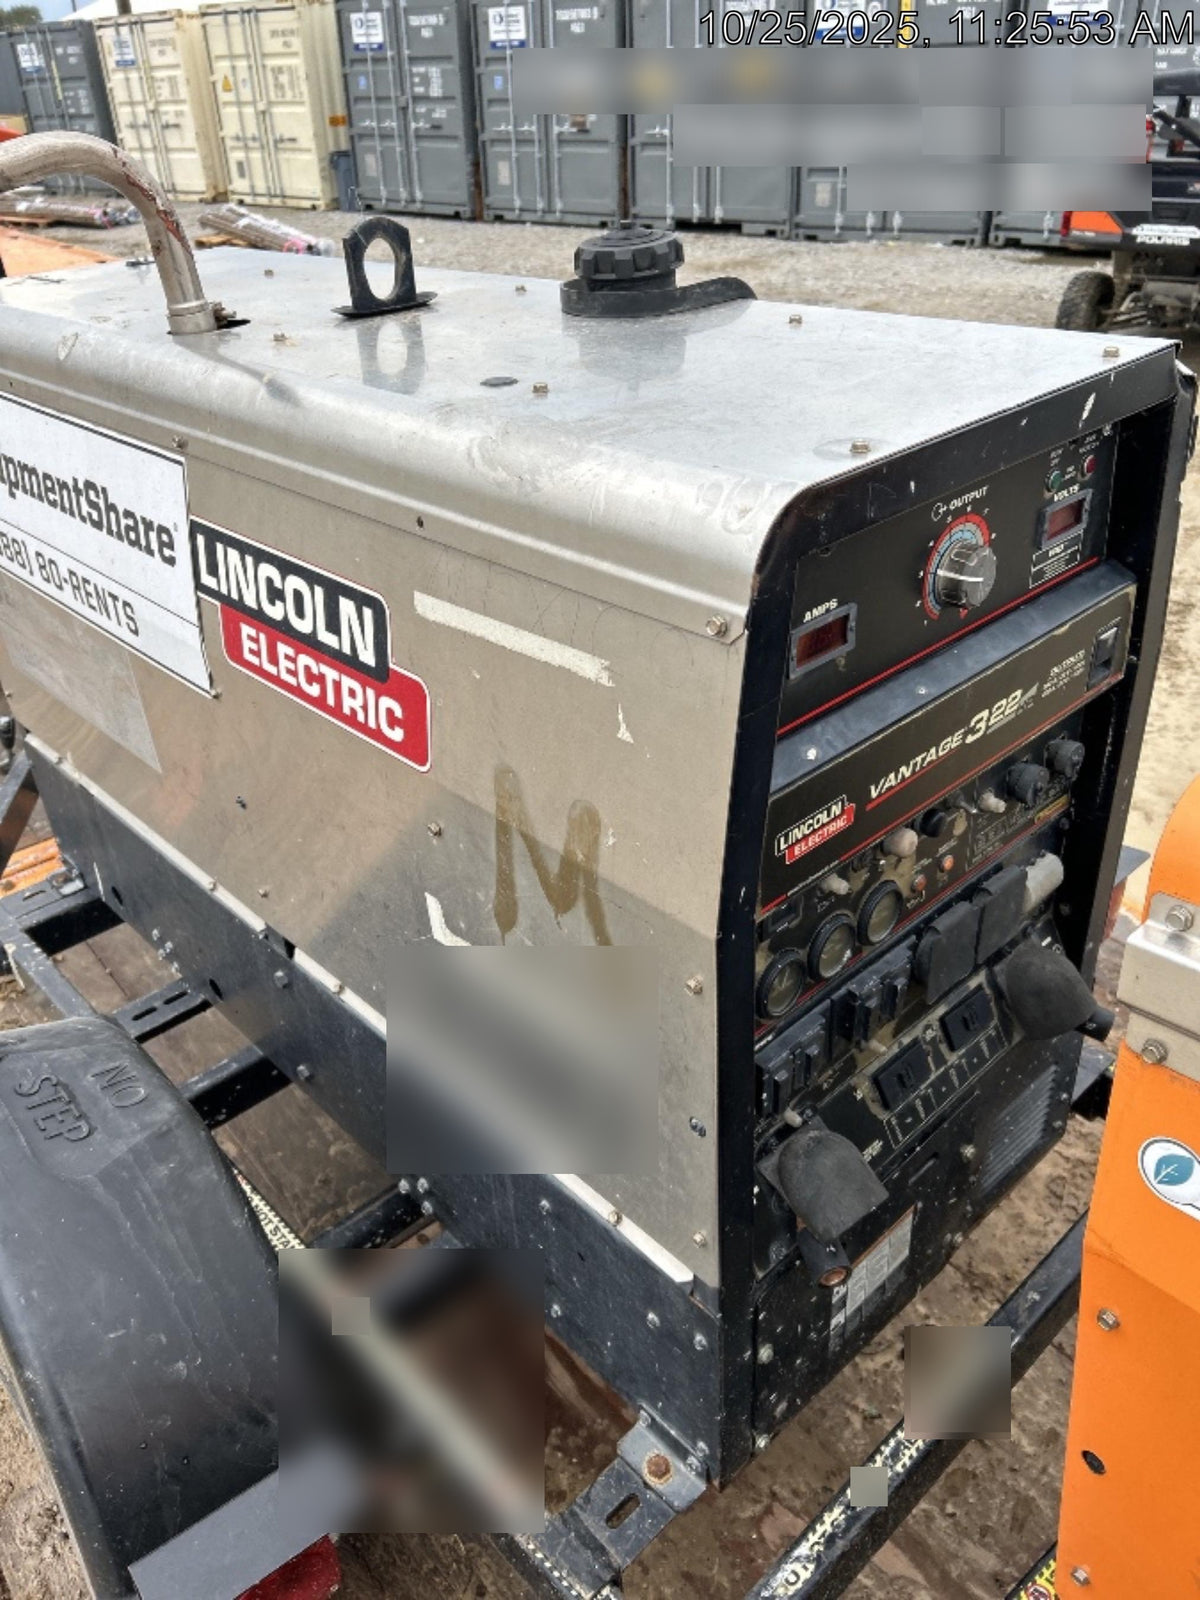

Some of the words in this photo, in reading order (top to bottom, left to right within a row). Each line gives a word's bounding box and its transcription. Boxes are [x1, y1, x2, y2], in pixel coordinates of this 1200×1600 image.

[949, 485, 990, 511] OUTPUT
[1054, 483, 1080, 502] VOLTS
[0, 531, 34, 577] 88)
[35, 551, 139, 637] 80-RENTS
[197, 533, 376, 668] LINCOLN
[803, 598, 839, 623] AMPS
[240, 622, 404, 742] ELECTRIC
[869, 728, 965, 799] VANTAGE
[965, 689, 1023, 744] 322
[780, 801, 842, 851] LINCOLN
[794, 815, 848, 856] ELECTRIC
[14, 1074, 91, 1142] STEP
[89, 1060, 149, 1109] NO
